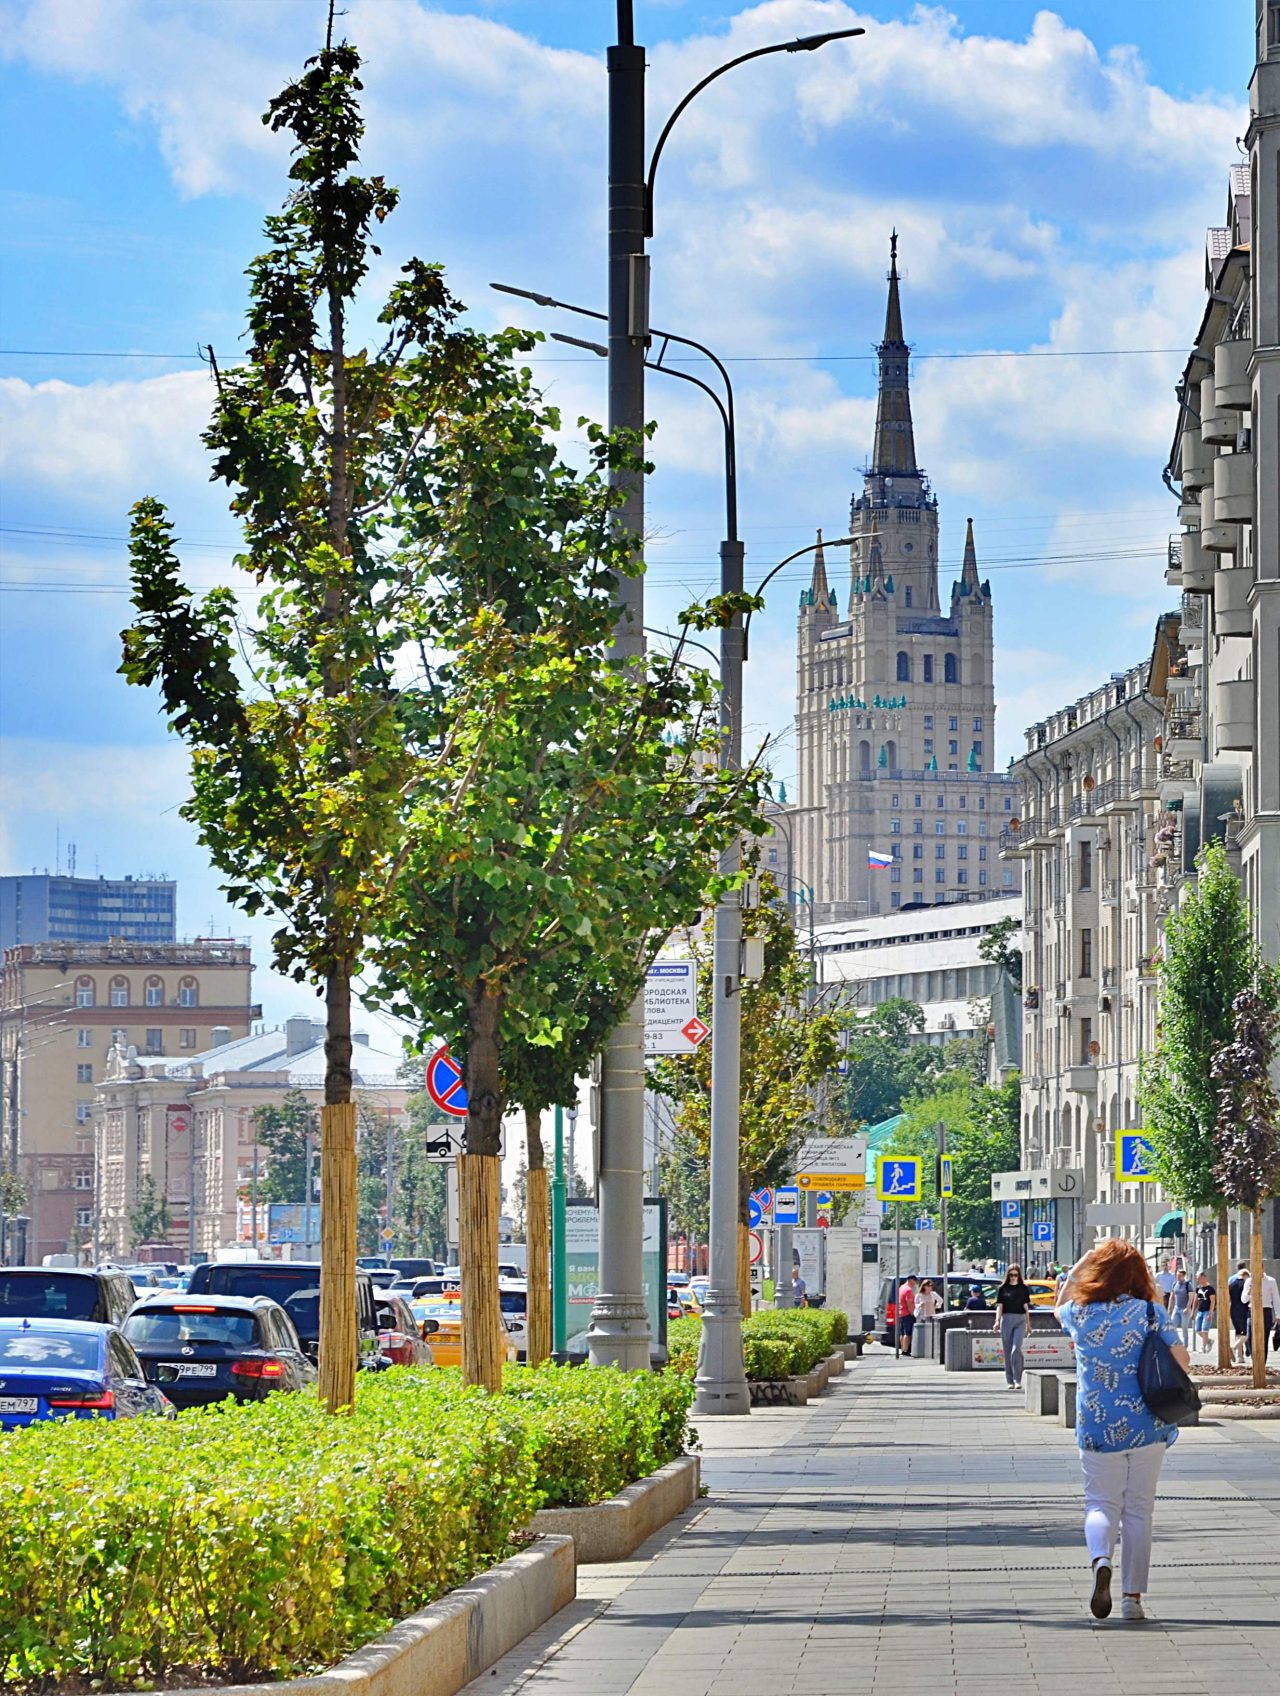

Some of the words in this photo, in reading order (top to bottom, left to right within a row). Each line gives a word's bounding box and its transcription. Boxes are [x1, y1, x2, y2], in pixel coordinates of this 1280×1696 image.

[441, 1282, 463, 1292] Ube
[200, 1364, 214, 1373] 799
[17, 1398, 35, 1408] 797
